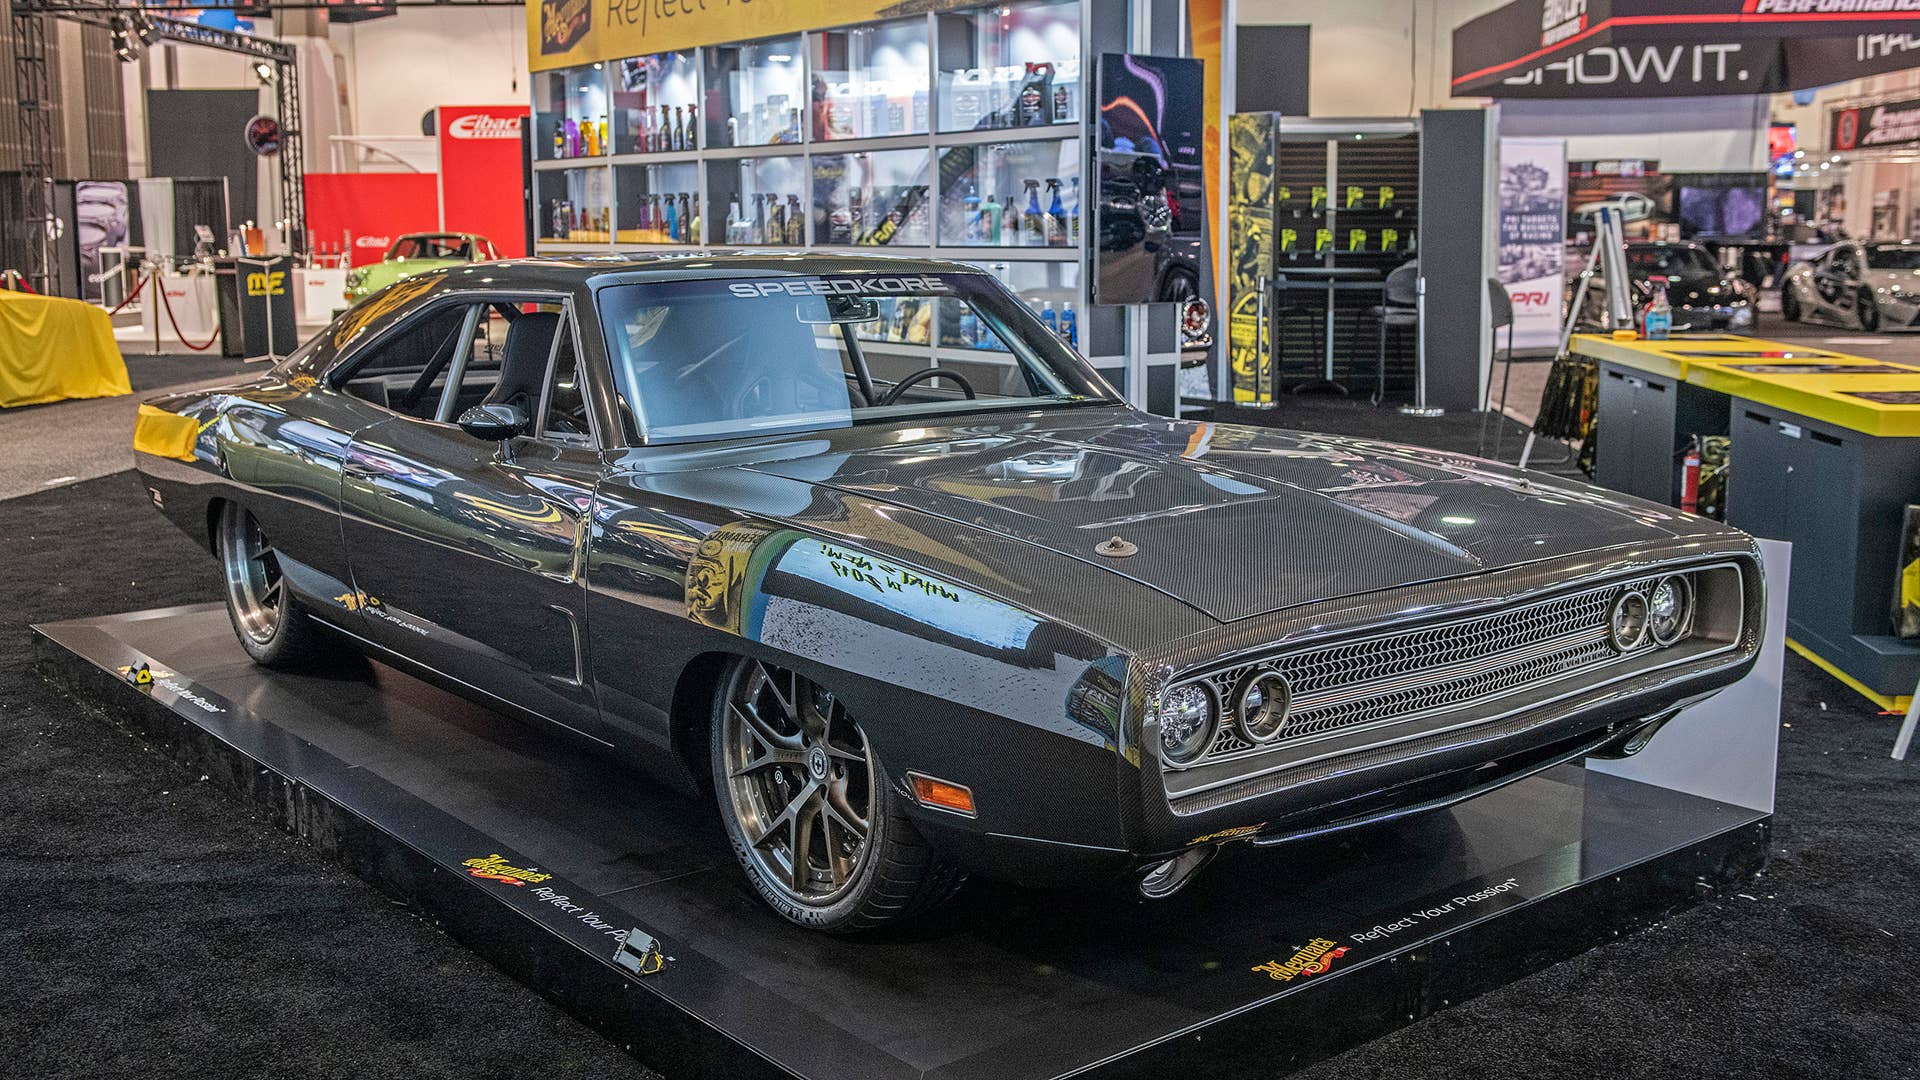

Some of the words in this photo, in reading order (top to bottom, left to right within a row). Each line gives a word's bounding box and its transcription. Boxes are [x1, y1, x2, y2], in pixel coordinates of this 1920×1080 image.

[1691, 43, 1749, 82] IT.
[728, 277, 949, 298] SPEEDKORE
[1510, 291, 1550, 306] PRI
[530, 887, 584, 914] Reflect
[577, 911, 613, 930] Your
[1251, 937, 1338, 982] Meguiar's
[1351, 916, 1418, 944] Reflect
[1413, 902, 1456, 920] Your
